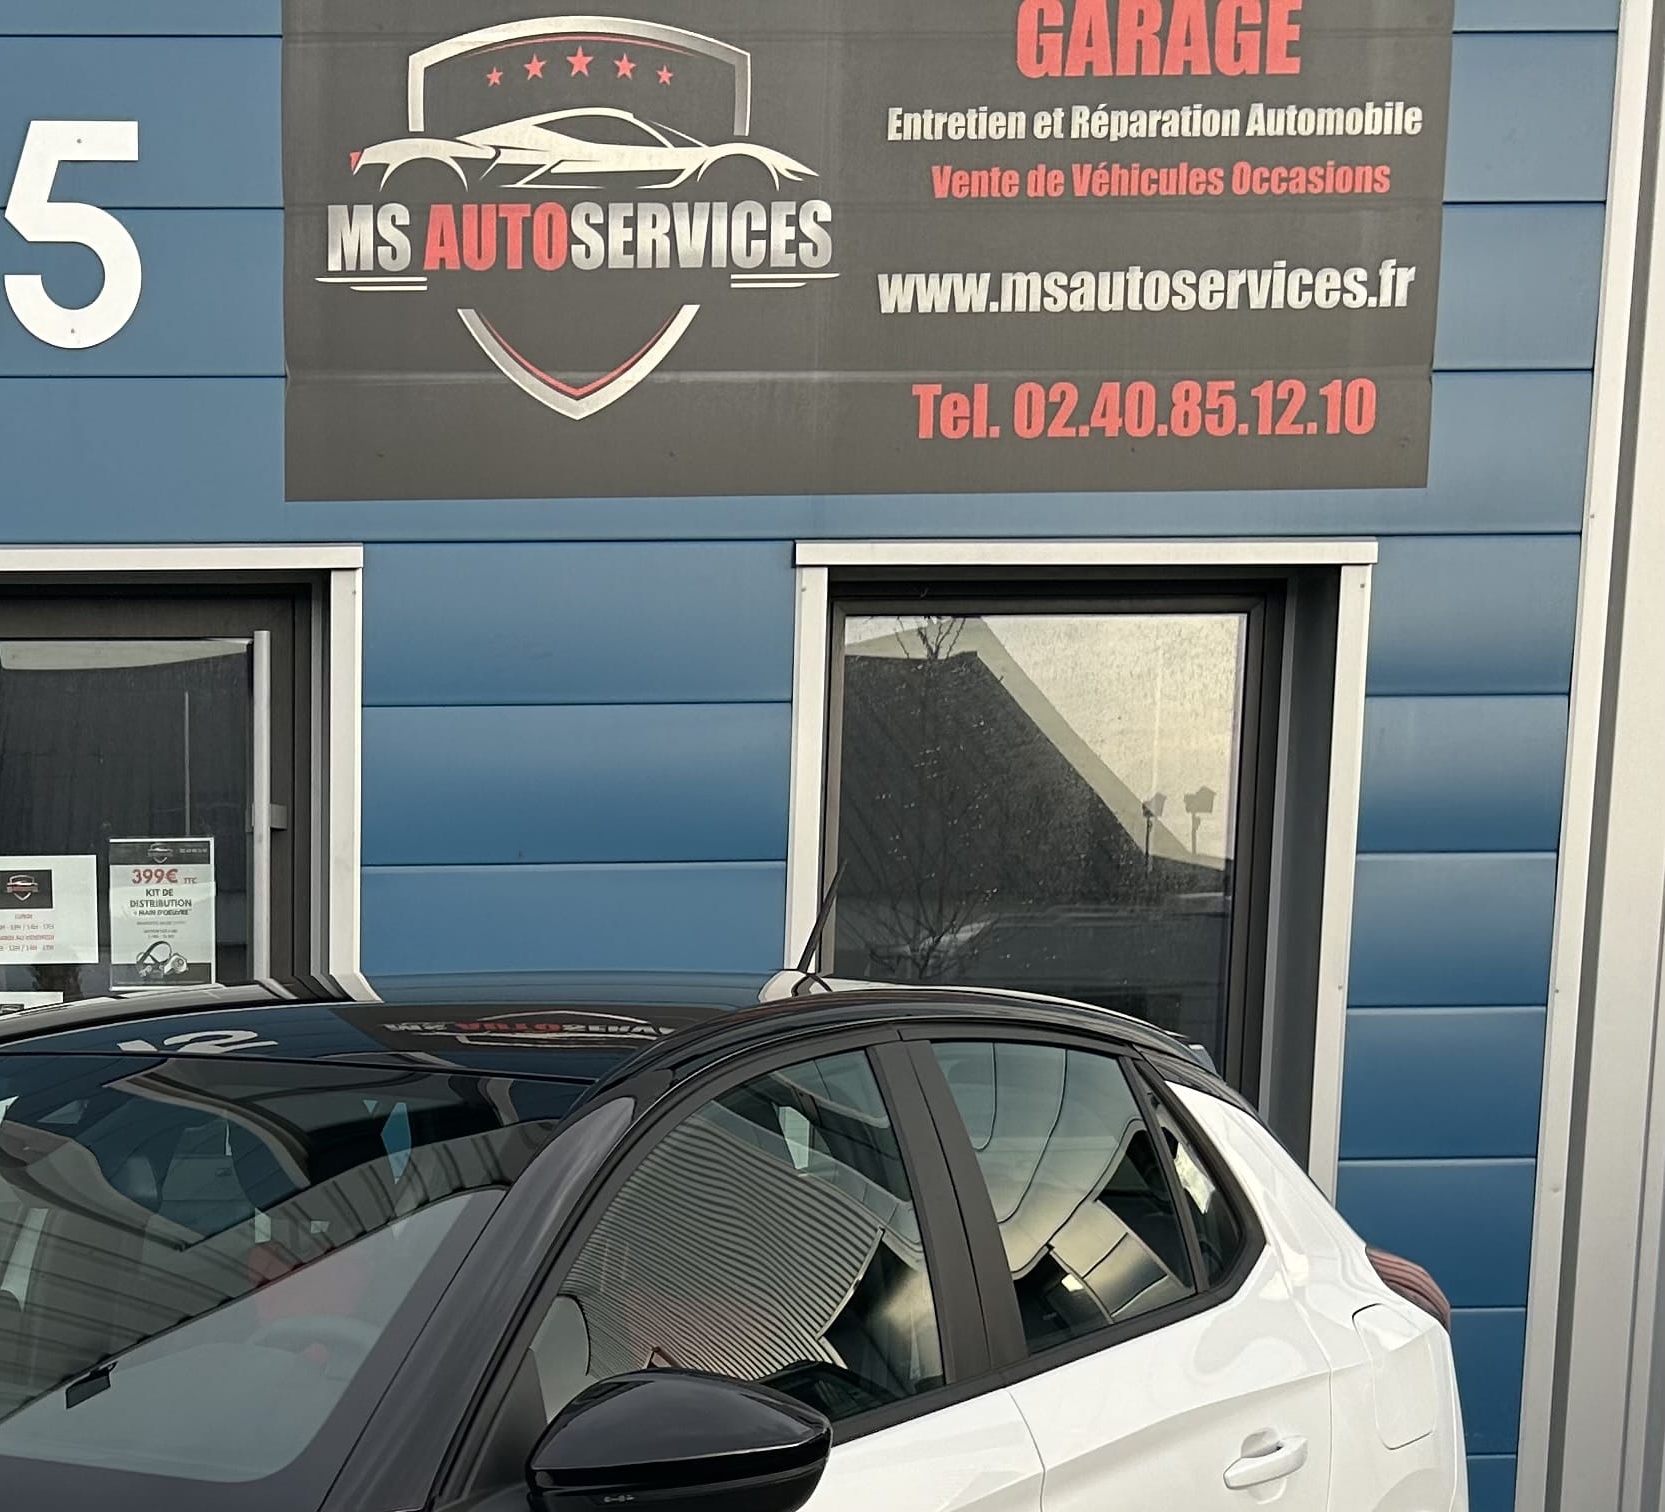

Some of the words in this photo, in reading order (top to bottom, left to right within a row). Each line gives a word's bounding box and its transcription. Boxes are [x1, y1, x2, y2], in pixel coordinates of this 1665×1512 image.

[1016, 0, 1302, 78] GARAGE
[887, 106, 1026, 141] Entretien
[1033, 108, 1065, 140] et
[1070, 104, 1240, 142] Réparation
[1245, 101, 1423, 137] Automobile
[931, 165, 1020, 199] Vente
[1027, 164, 1065, 198] de
[1072, 161, 1224, 197] Véhicules
[1231, 160, 1391, 195] Occasions
[327, 203, 412, 272] MS
[423, 200, 832, 271] AUTOSERVICES
[877, 259, 1416, 313] www.msautoservices.fr
[912, 383, 1000, 440] Tel.
[1013, 377, 1377, 439] 02.40.85.12.10
[132, 868, 178, 884] 399€
[130, 899, 192, 907] DISTRIBUTION
